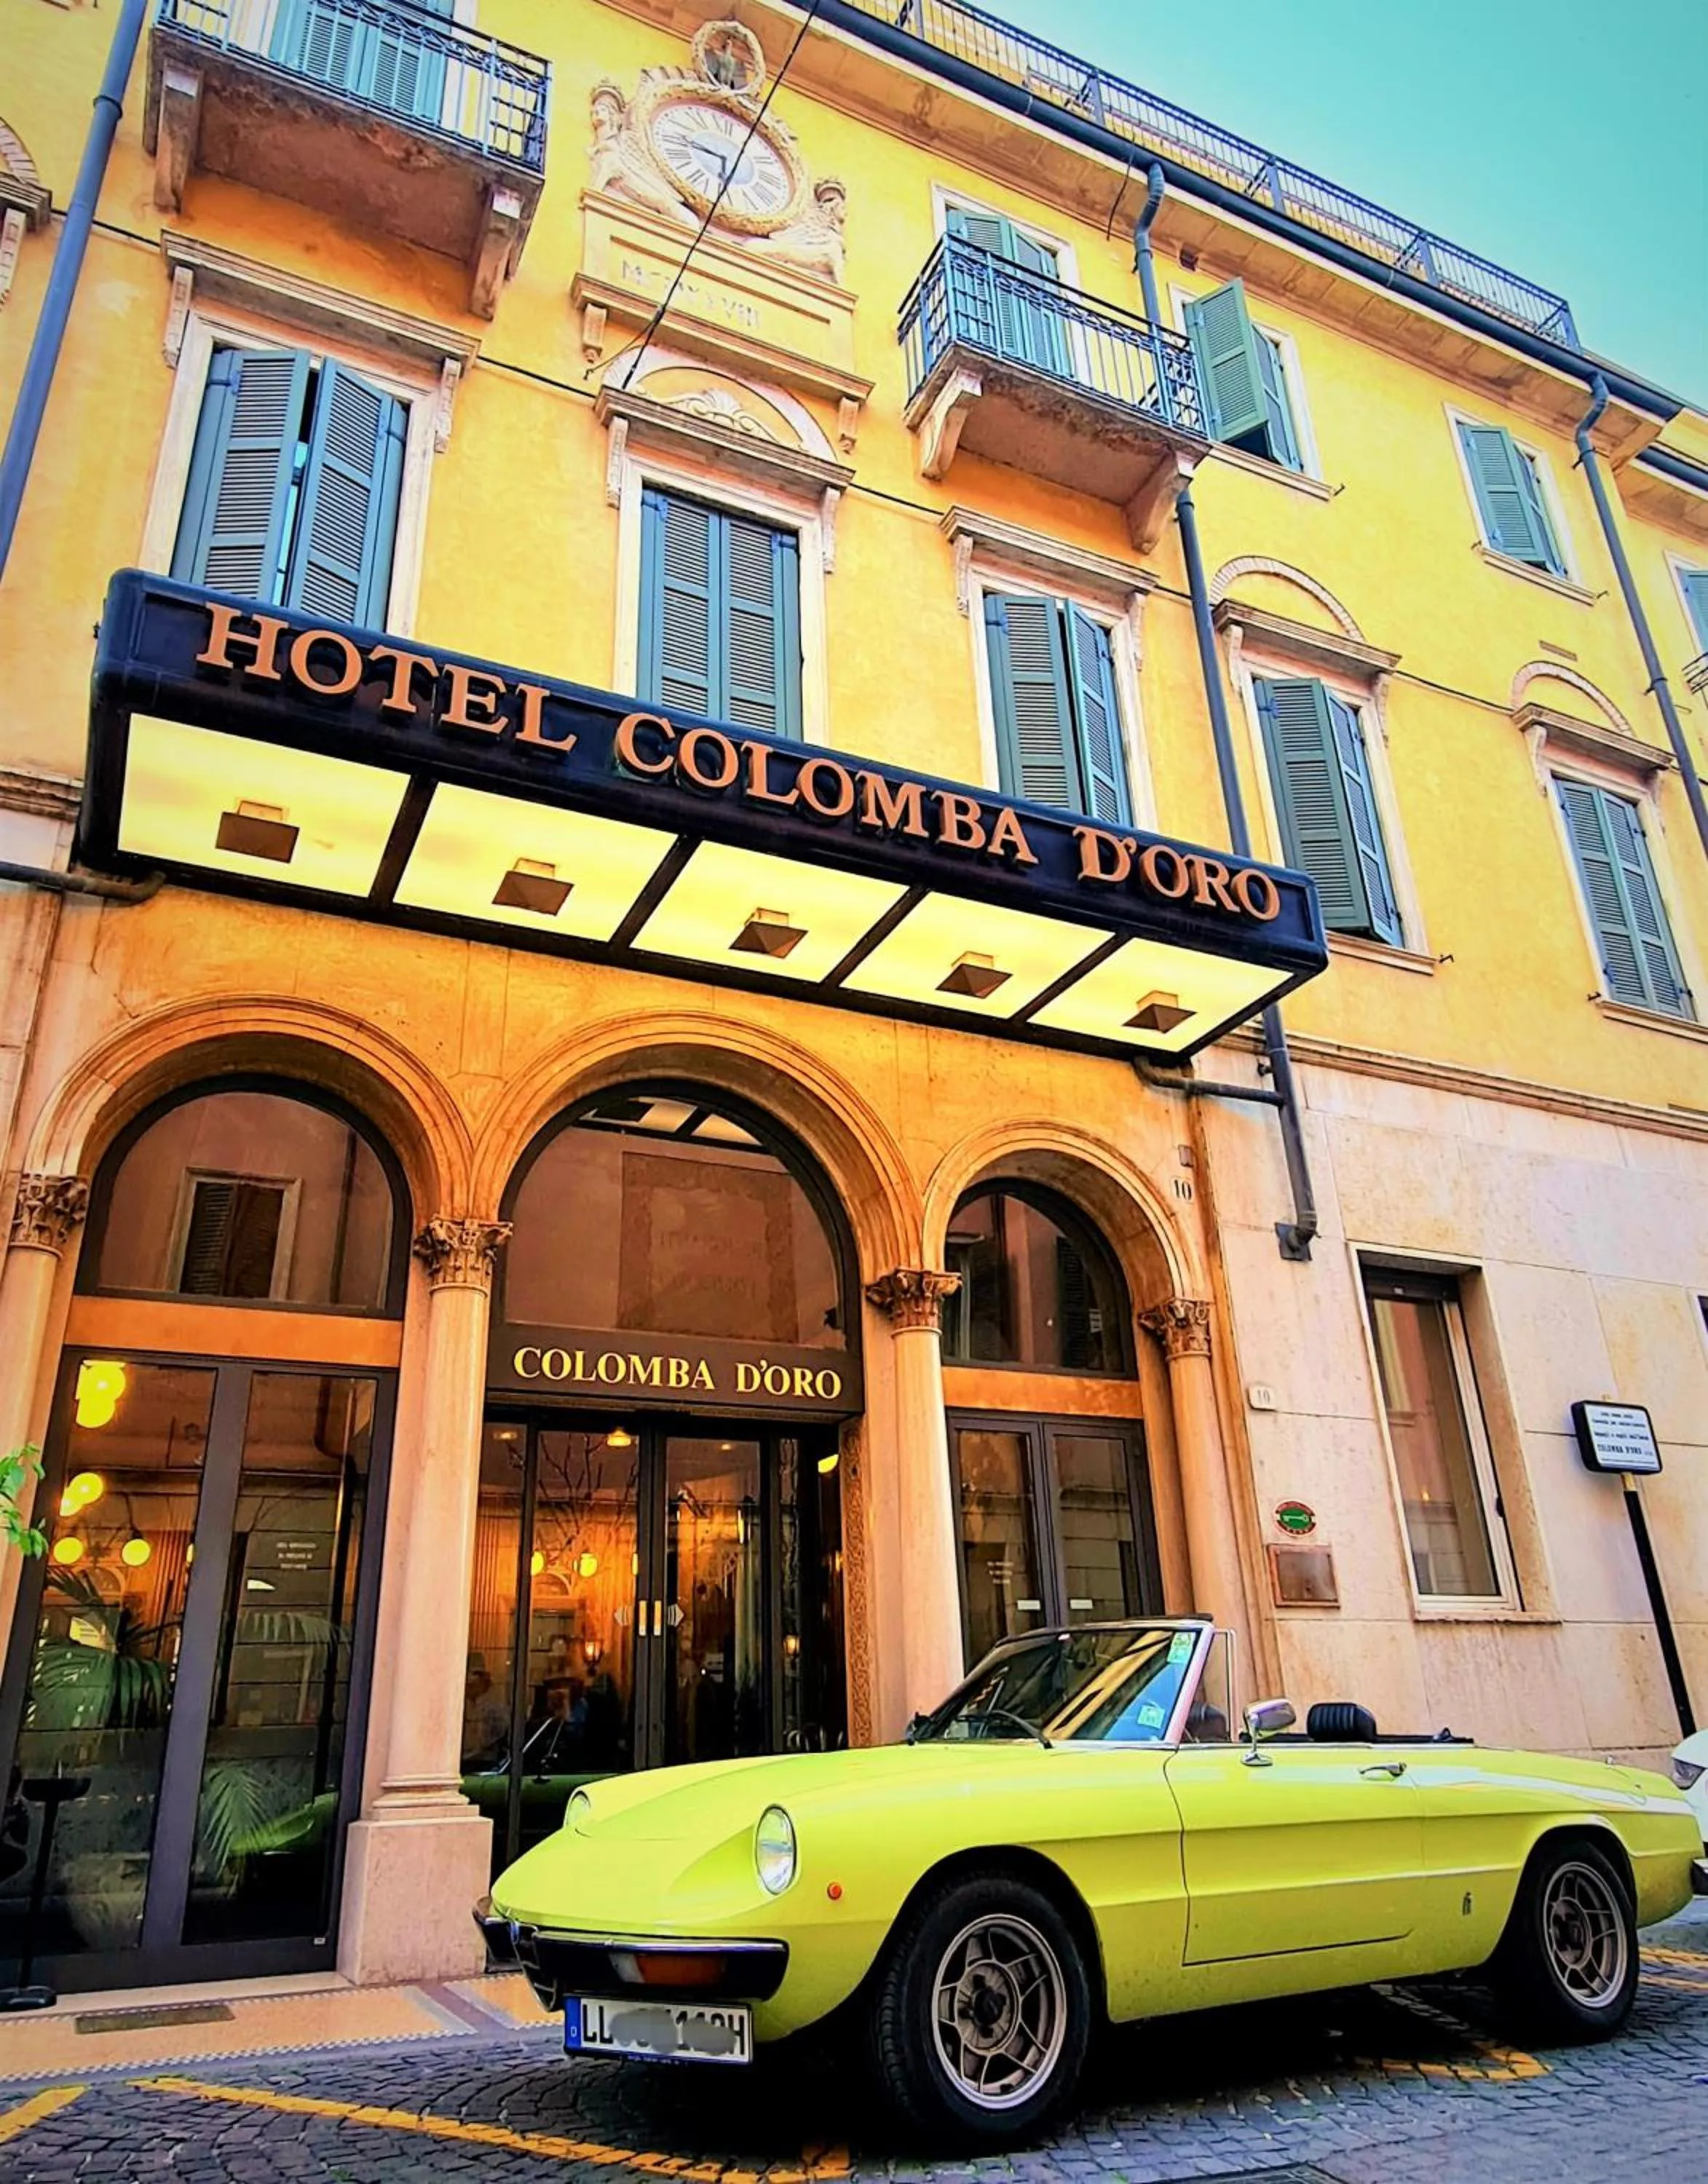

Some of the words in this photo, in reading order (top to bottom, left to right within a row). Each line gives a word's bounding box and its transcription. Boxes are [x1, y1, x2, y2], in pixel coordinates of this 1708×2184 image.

[196, 602, 577, 753] HOTEL
[614, 712, 1039, 864] COLOMBA
[1072, 826, 1281, 922] D'ORO
[1174, 1179, 1193, 1200] 10
[513, 1346, 716, 1390] COLOMBA
[735, 1359, 842, 1399] D'ORO
